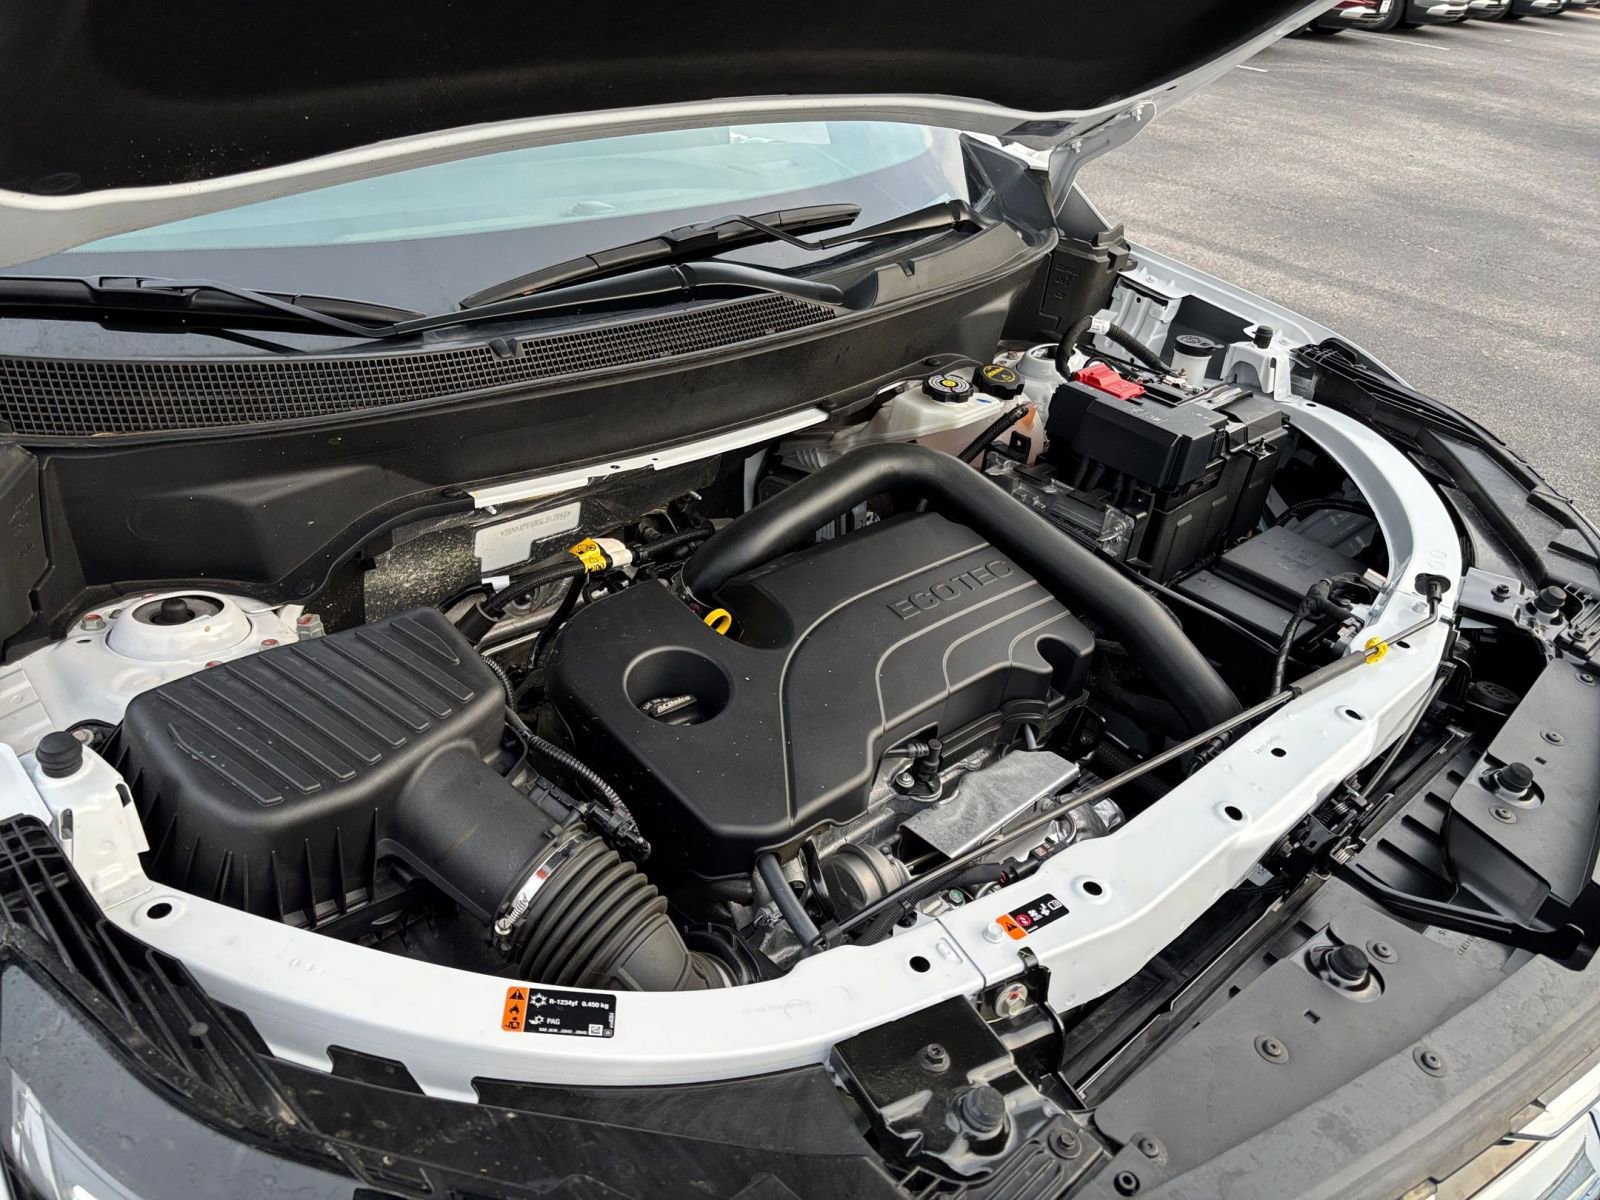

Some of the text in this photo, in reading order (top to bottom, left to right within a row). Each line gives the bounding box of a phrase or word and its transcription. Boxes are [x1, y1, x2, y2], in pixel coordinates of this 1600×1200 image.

[886, 560, 1014, 620] ECOTEC
[657, 695, 691, 714] ACDelco
[548, 998, 609, 1010] R-1234yf 0.450 kg
[546, 1017, 560, 1026] PAG
